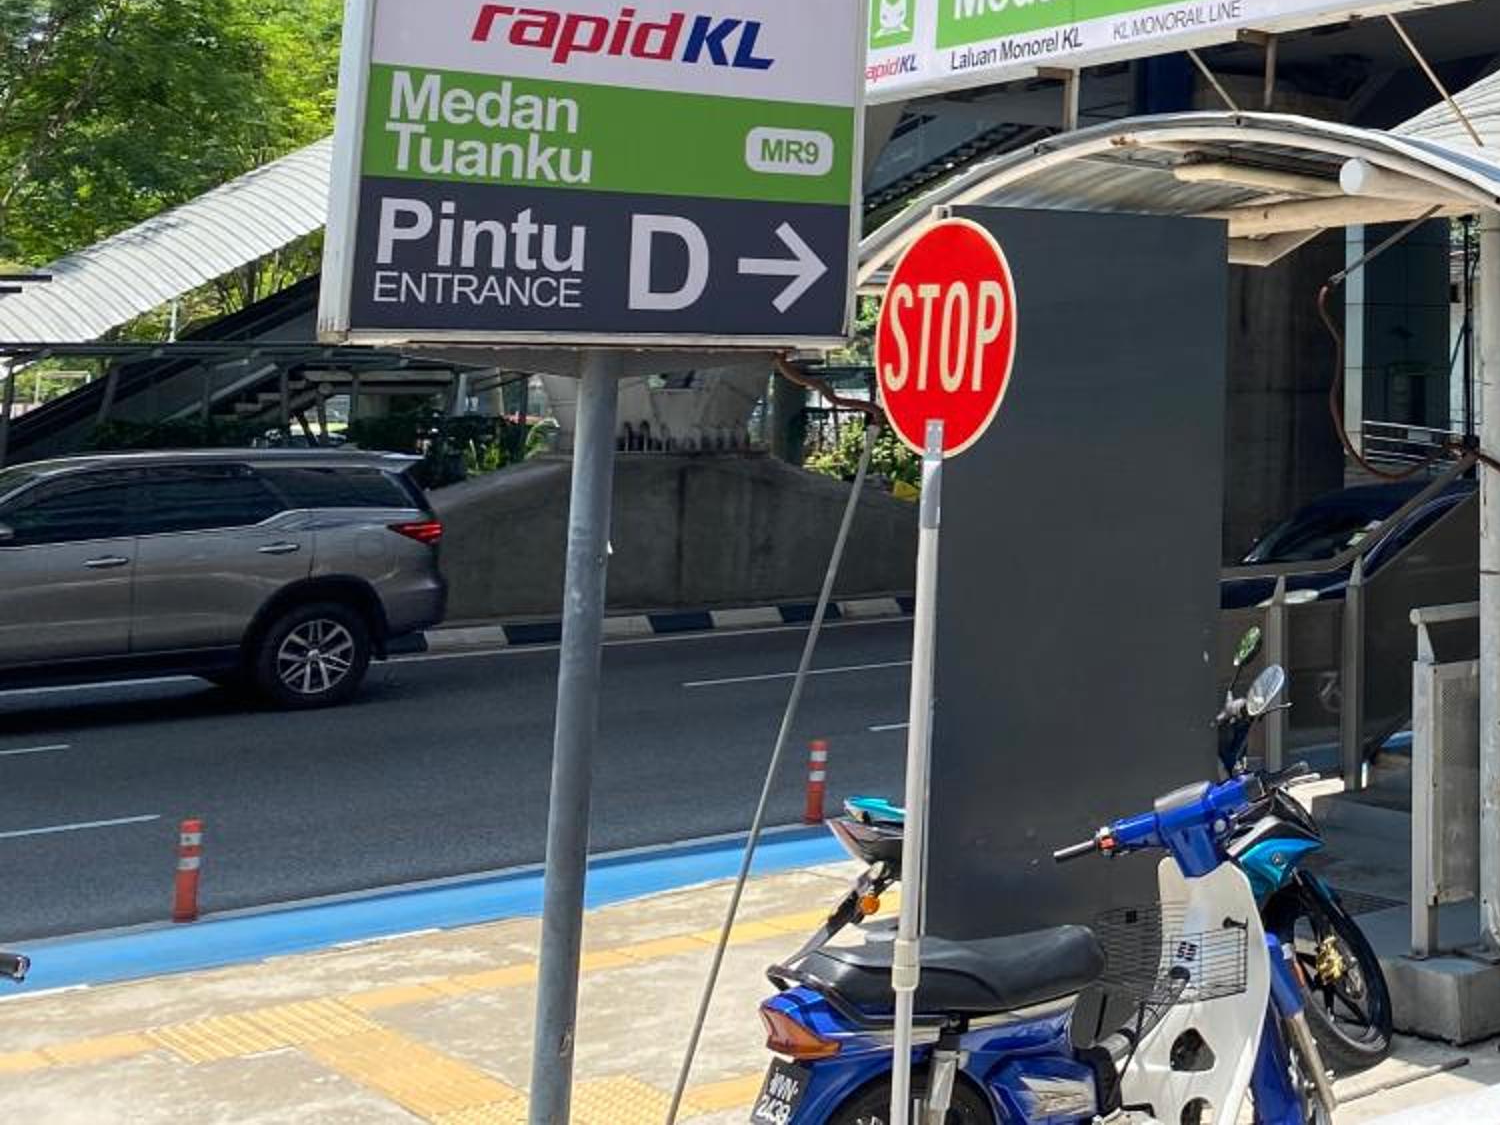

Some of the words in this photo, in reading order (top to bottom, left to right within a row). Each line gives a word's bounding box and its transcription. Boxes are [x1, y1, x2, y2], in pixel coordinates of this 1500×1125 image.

[471, 3, 776, 70] rapidKL
[950, 46, 997, 71] Laluan
[999, 33, 1059, 61] Monorel
[1061, 26, 1083, 49] KL
[1132, 5, 1207, 36] MONORAIL
[865, 53, 918, 83] apidKL
[389, 70, 579, 134] Medan
[385, 120, 593, 184] Tuanku
[760, 138, 819, 166] MR9
[376, 196, 587, 273] Pintu
[627, 212, 711, 312] D
[373, 270, 583, 308] ENTRANCE
[884, 280, 1005, 393] STOP
